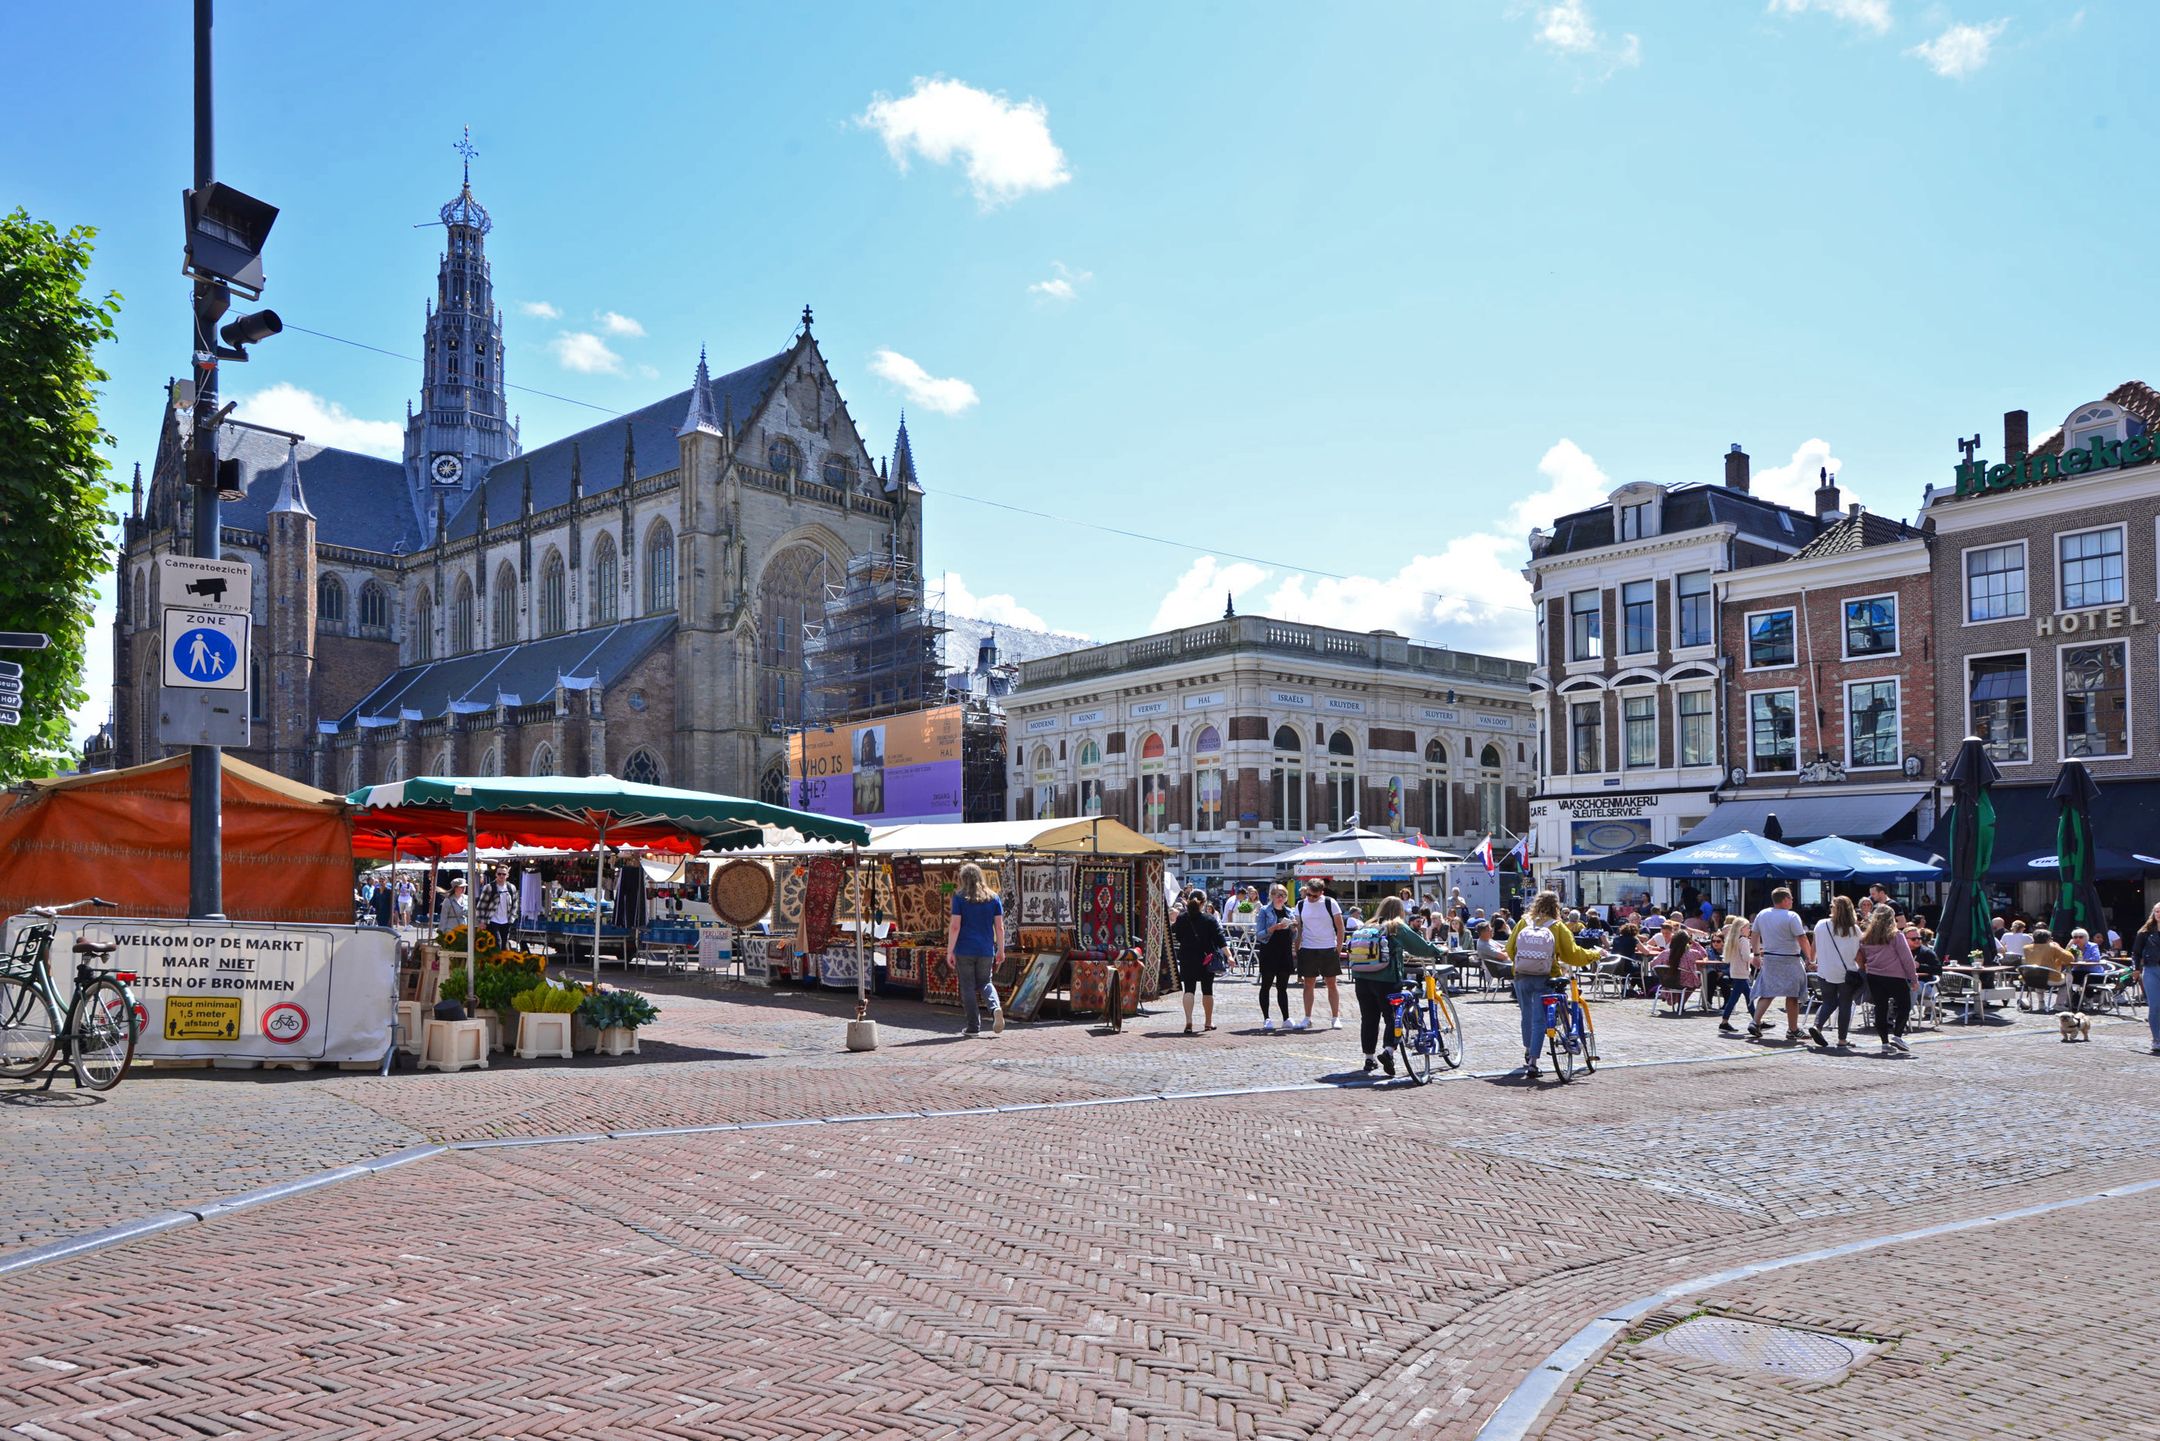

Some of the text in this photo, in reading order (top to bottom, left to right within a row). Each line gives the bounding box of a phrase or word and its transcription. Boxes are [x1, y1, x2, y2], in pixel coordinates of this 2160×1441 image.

[165, 559, 248, 575] Cameratoezicht
[186, 614, 226, 626] ZONE
[2037, 606, 2145, 637] HOTEL
[1198, 696, 1211, 704] HAL
[1329, 699, 1360, 710] KRUYDER
[1138, 704, 1161, 712] VERWEY
[1079, 713, 1096, 721] KUNST
[1425, 710, 1453, 719] SLUYTERS
[1030, 720, 1055, 729] MODERNE
[1480, 716, 1507, 726] VAN LOOY
[799, 757, 827, 776] WHO
[832, 755, 843, 774] IS
[799, 780, 827, 799] SHE?
[114, 935, 303, 951] WELKOM OP DE MARKT
[162, 957, 255, 969] MAAR NIET
[187, 978, 206, 988] OF
[211, 978, 294, 991] BROMMEN
[180, 1010, 193, 1018] 1,5
